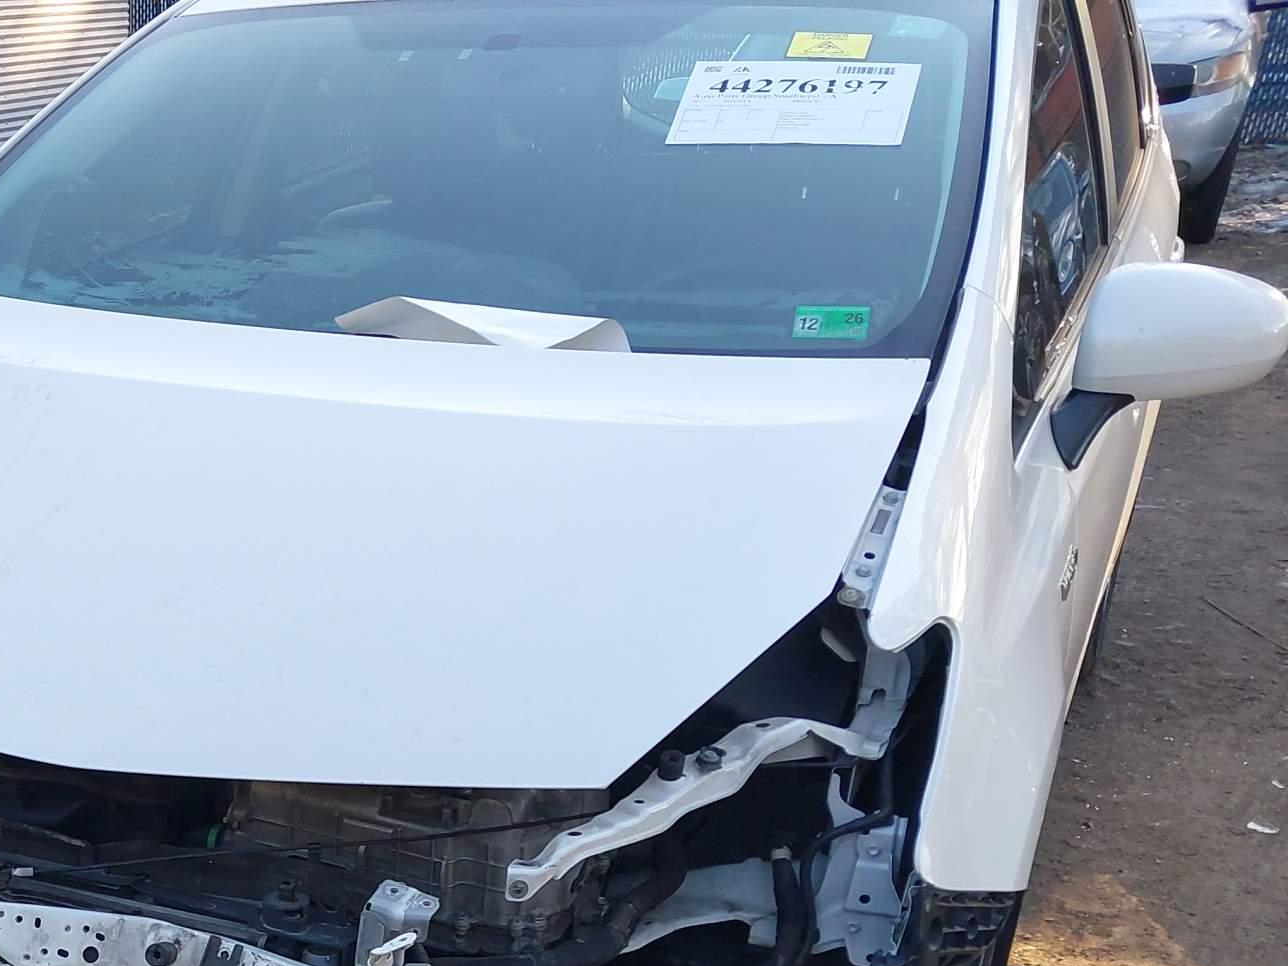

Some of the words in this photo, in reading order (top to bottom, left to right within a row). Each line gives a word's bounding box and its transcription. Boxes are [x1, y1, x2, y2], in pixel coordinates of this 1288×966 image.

[709, 78, 889, 96] 44276197
[799, 317, 819, 331] 12
[845, 312, 865, 324] 26
